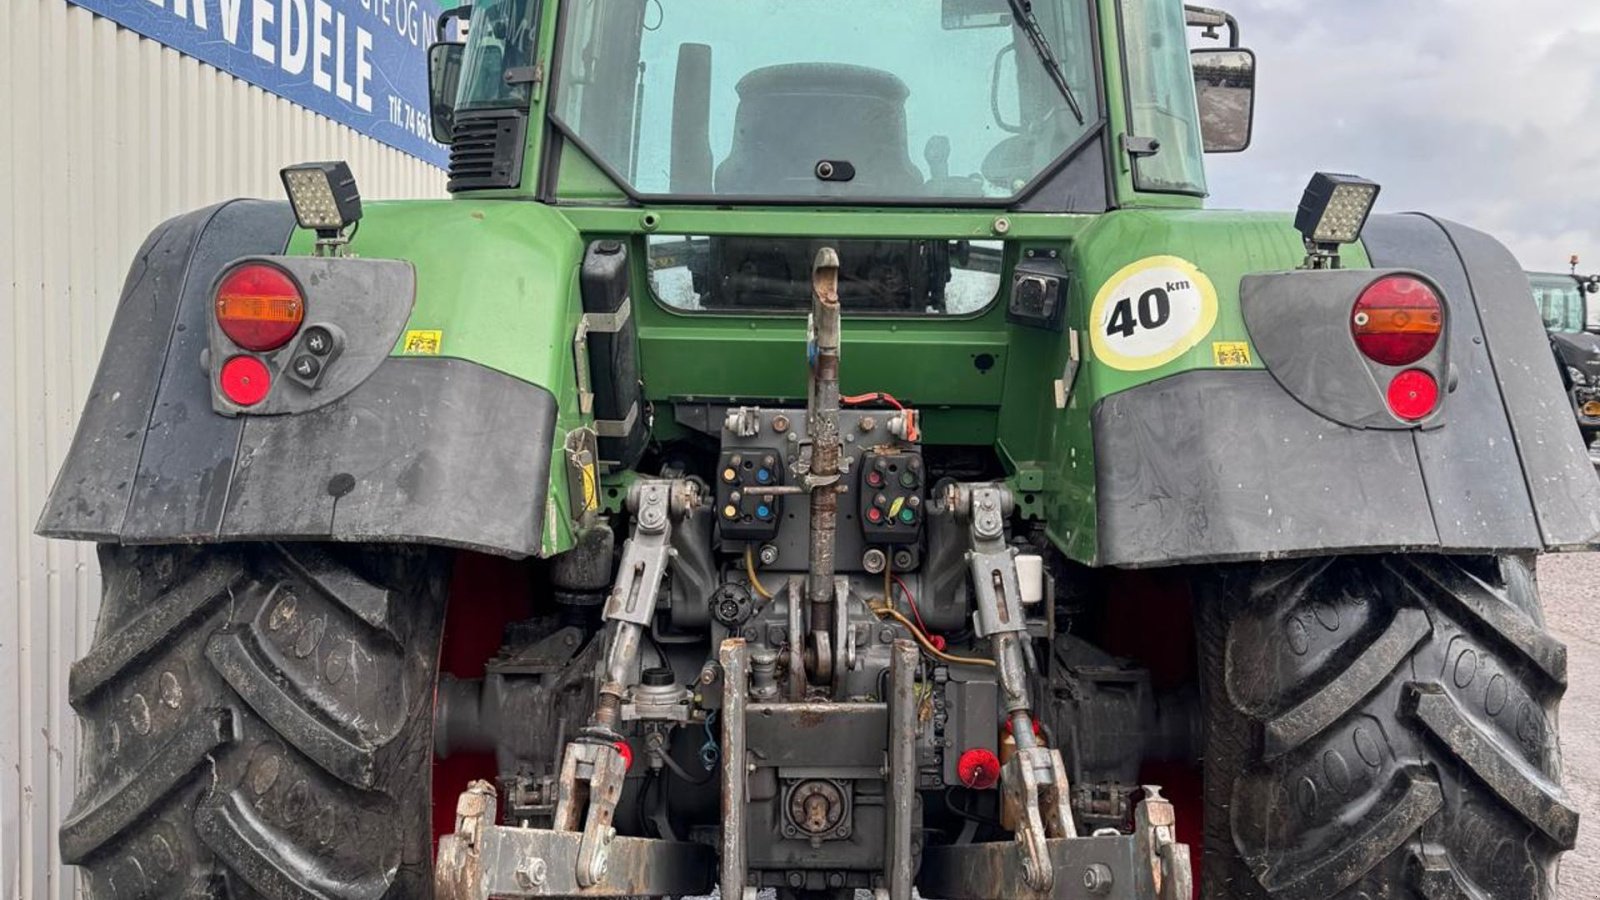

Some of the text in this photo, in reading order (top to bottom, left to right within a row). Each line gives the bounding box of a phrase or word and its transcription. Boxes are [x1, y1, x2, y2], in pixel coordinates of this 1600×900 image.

[396, 0, 418, 46] OG
[145, 0, 373, 113] VEDELE
[388, 94, 404, 128] Tlf.
[405, 103, 415, 134] 74
[417, 111, 426, 140] 66
[1106, 280, 1190, 338] 40 km
